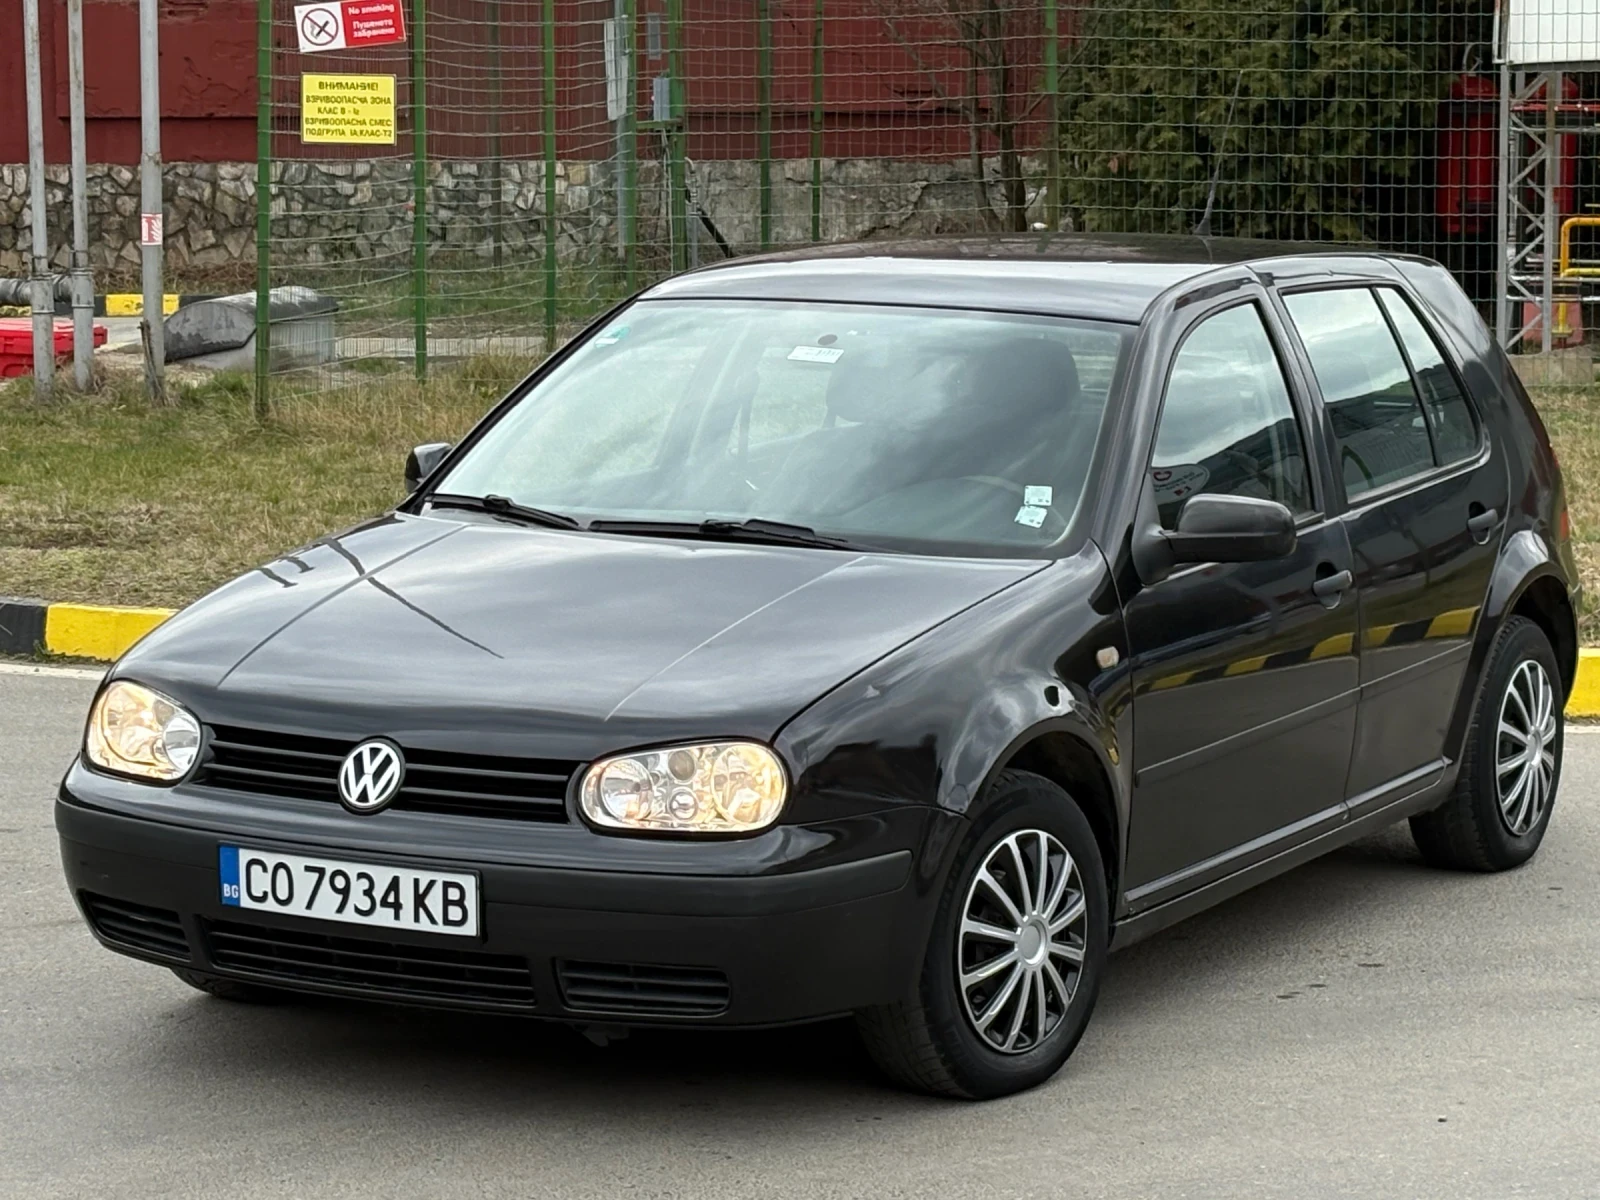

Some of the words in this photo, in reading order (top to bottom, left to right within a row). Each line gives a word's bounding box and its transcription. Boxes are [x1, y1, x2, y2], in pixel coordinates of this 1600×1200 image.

[348, 6, 360, 15] No
[361, 3, 395, 14] smoking
[370, 96, 392, 105] ЗОНА
[317, 106, 339, 115] КЛАС
[340, 742, 400, 806] VW
[223, 883, 239, 899] BG
[304, 864, 403, 921] 7934
[413, 877, 469, 927] KB
